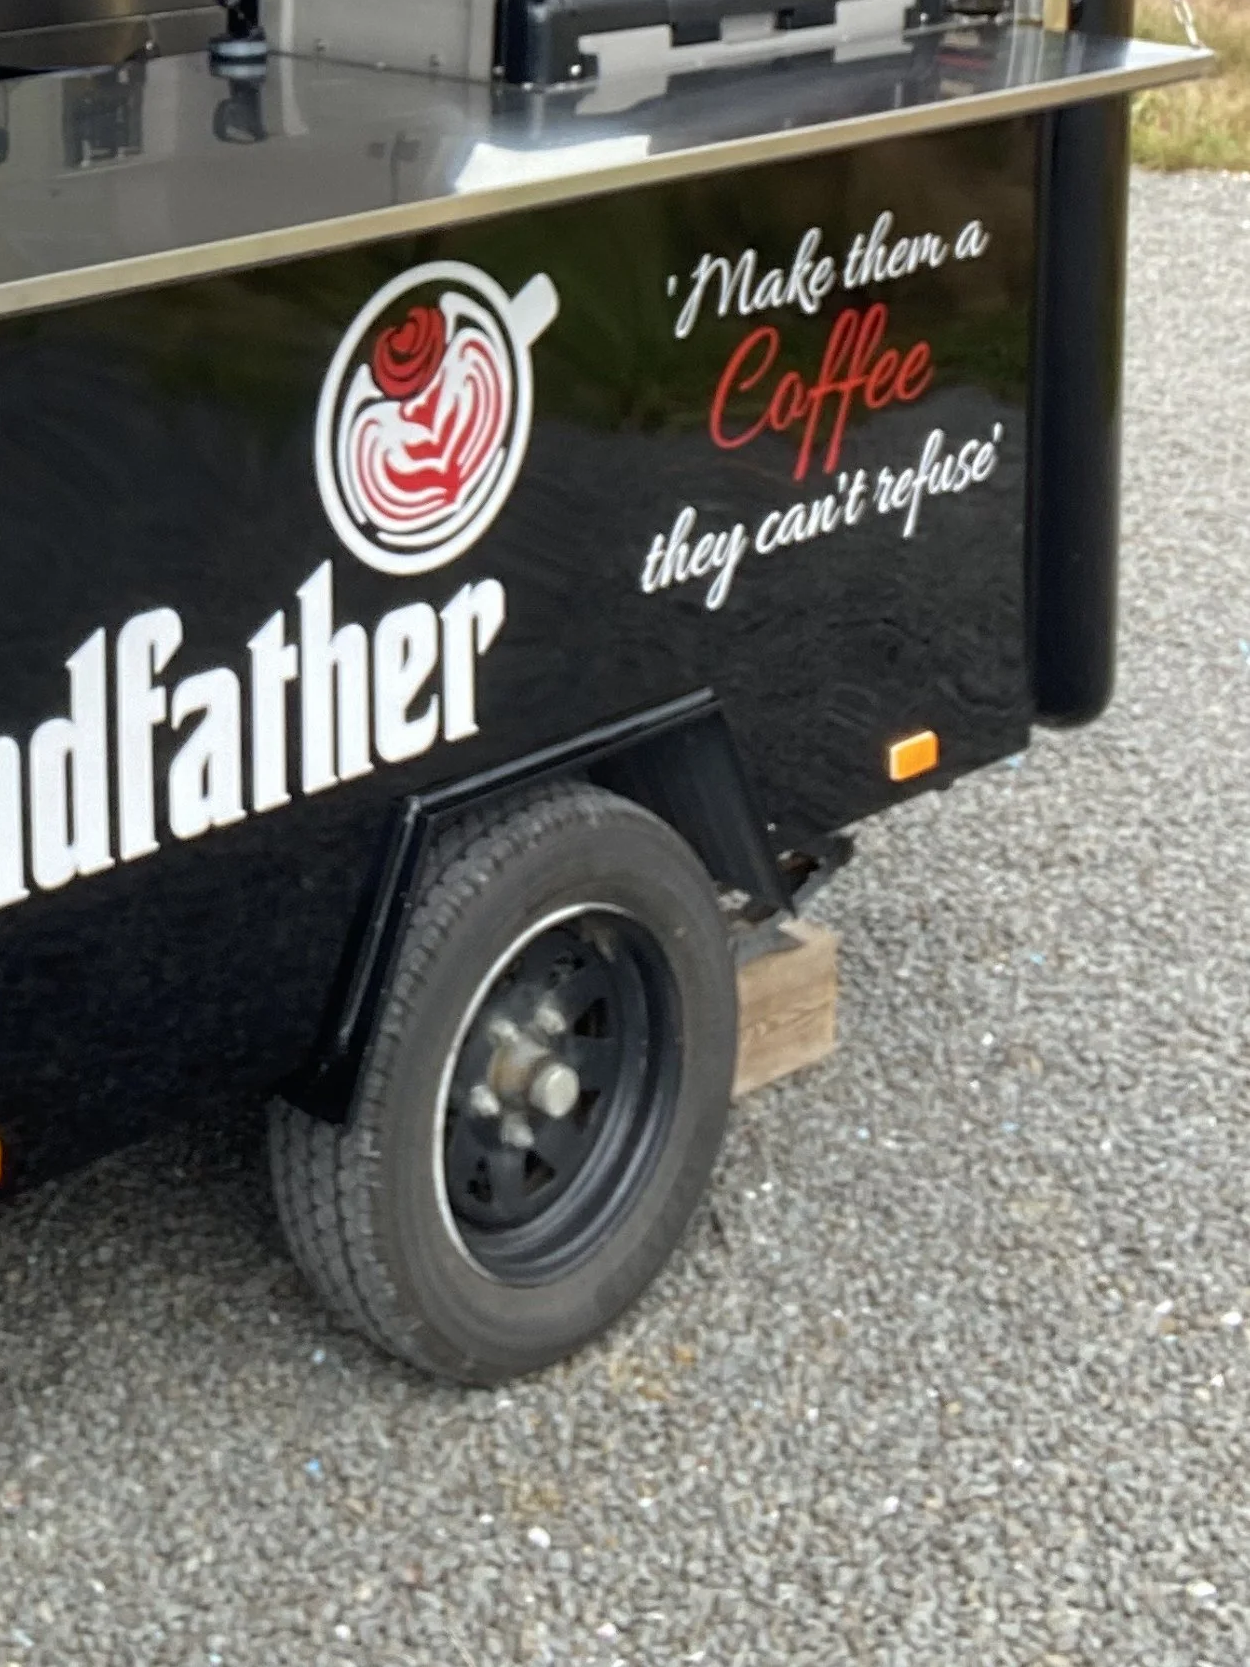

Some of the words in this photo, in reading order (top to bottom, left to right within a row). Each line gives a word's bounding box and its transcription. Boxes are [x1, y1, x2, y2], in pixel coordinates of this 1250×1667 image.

[843, 209, 949, 289] them
[954, 219, 989, 259] a
[710, 301, 934, 482] Coffee
[641, 505, 749, 611] they
[754, 468, 870, 554] can't
